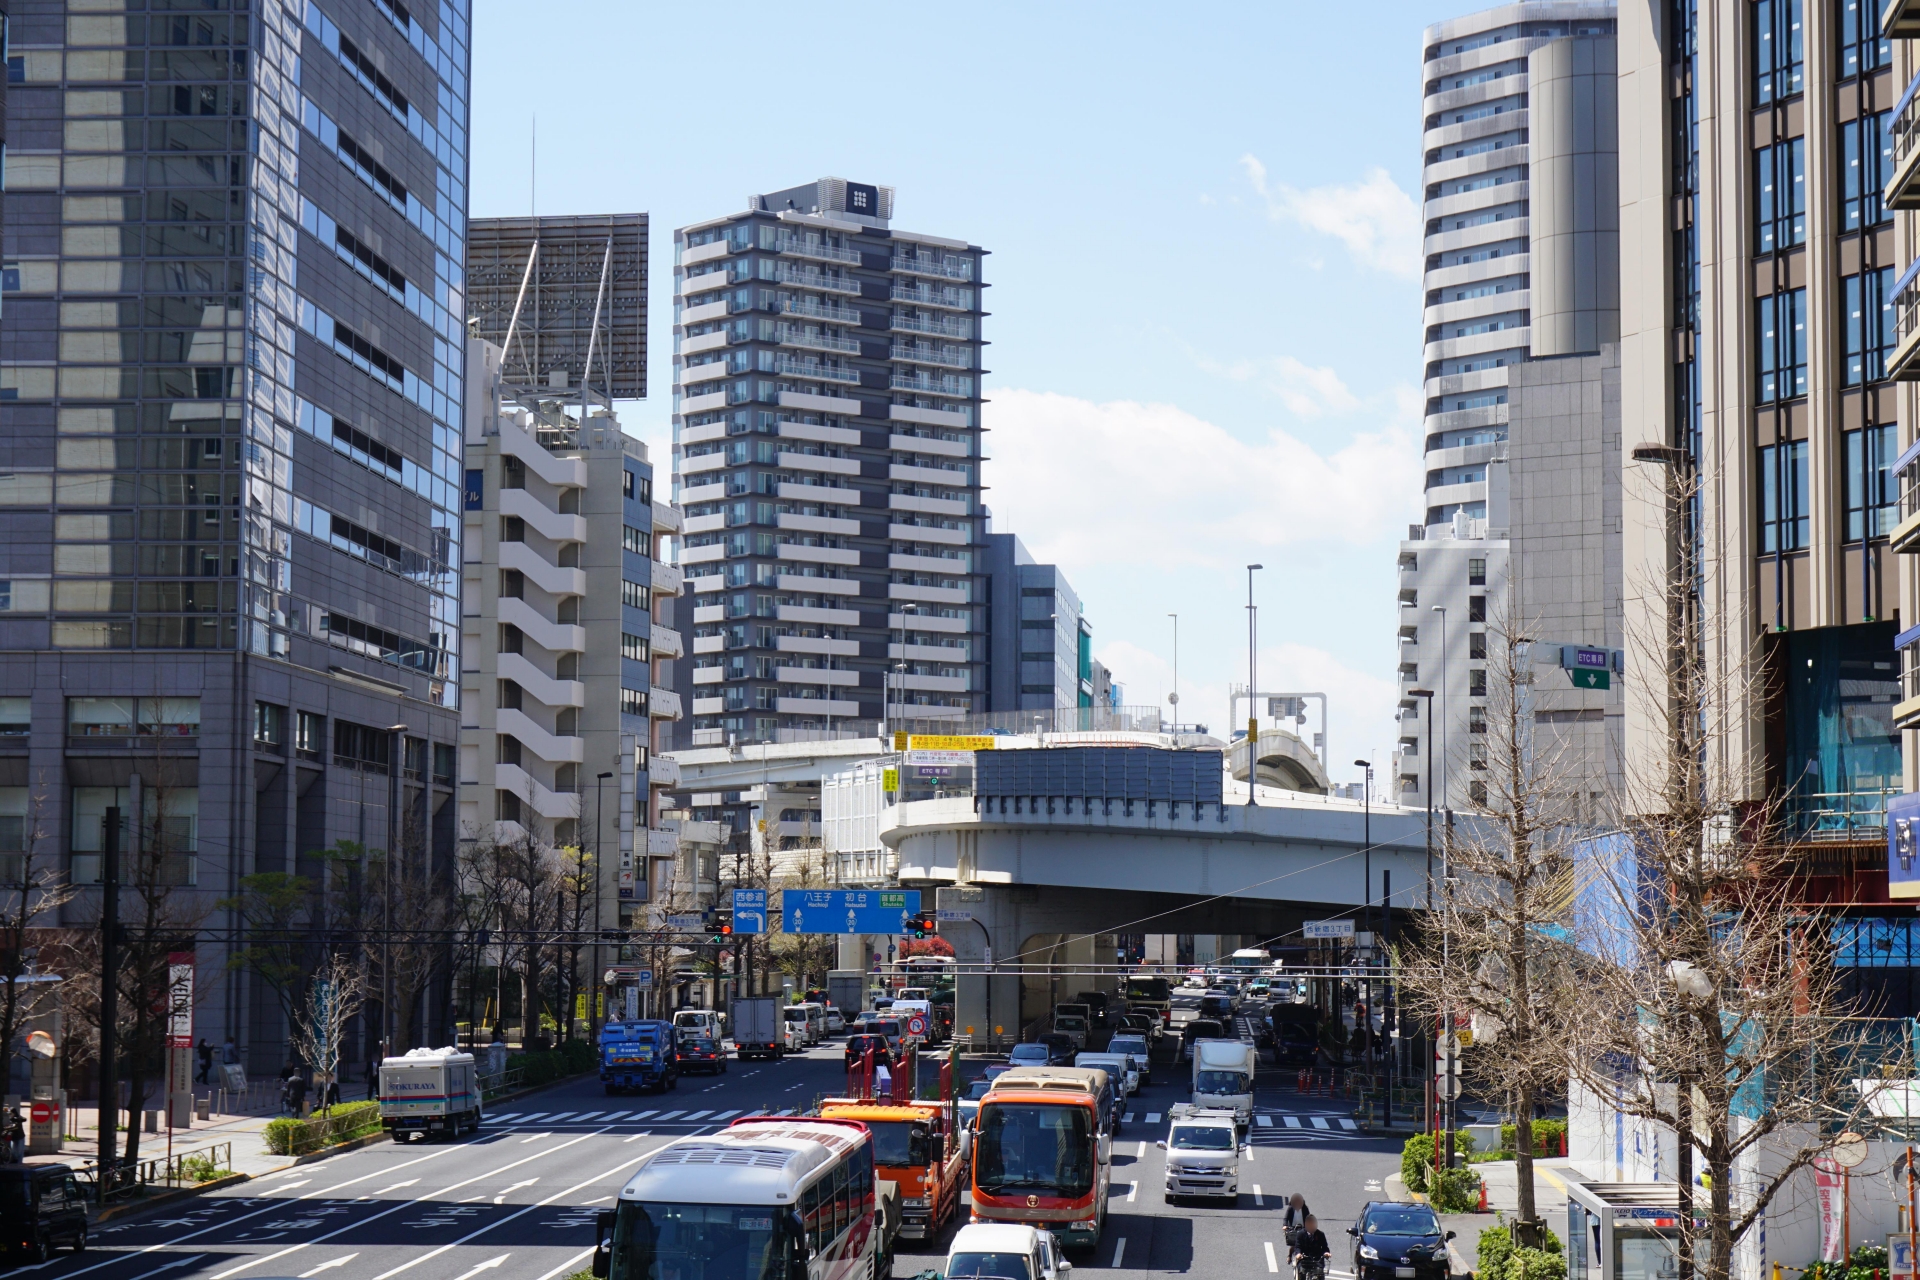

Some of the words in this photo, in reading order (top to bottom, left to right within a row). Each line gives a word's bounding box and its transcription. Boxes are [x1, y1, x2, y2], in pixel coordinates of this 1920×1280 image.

[1578, 653, 1604, 664] ETC専用
[736, 892, 764, 902] 西参道
[804, 892, 832, 901] 八王子
[845, 892, 867, 902] 初台
[881, 894, 904, 902] 首都高
[1306, 924, 1351, 933] 西新宿3丁目
[640, 971, 651, 982] P
